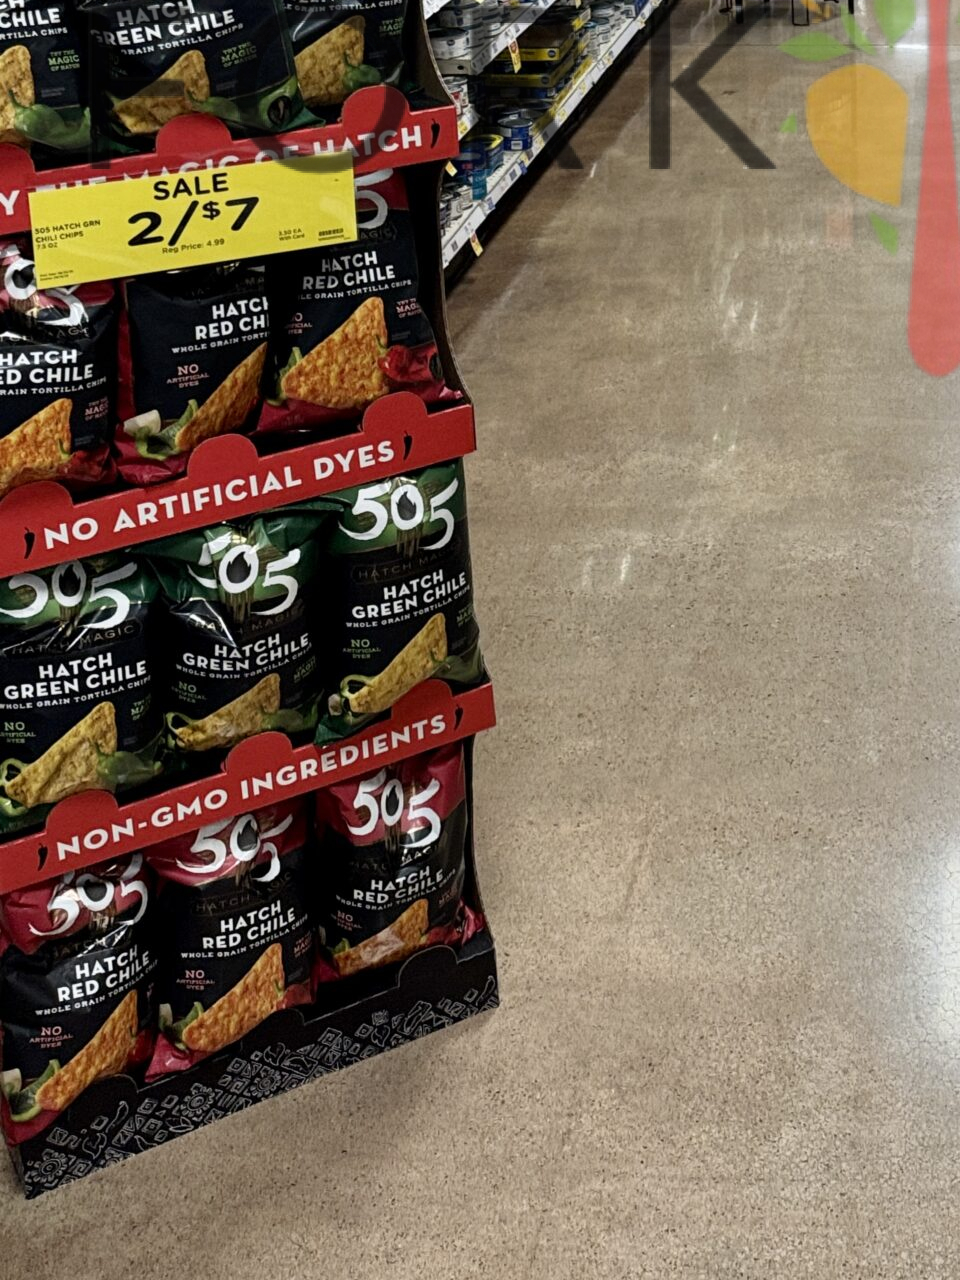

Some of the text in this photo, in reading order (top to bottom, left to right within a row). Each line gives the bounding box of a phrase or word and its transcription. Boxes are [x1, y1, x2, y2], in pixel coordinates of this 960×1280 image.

[117, 0, 195, 27] HATCH
[168, 9, 235, 37] CHILE
[313, 124, 422, 158] HATCH
[153, 172, 229, 200] SALE
[35, 219, 101, 235] 505 HATCH GRN
[128, 197, 259, 247] 2/$7
[35, 230, 84, 243] CHILI CHIPS
[162, 245, 179, 255] Reg
[206, 238, 225, 247] 4.99
[321, 250, 378, 274] HATCH
[302, 265, 396, 291] RED CHILE
[346, 284, 389, 297] TORTILLA
[195, 321, 233, 341] RED
[172, 342, 207, 354] WHOLE
[29, 363, 94, 385] CHILE
[177, 363, 199, 375] NO
[31, 383, 84, 395] TORTILLA
[44, 440, 394, 549] NO ARTIFICIAL DYES
[338, 477, 459, 550] 505
[352, 572, 467, 619] GREEN CHILE
[383, 568, 444, 600] HATCH
[345, 612, 411, 629] WHOLE GRAIN
[183, 633, 309, 672] GREEN CHILE
[214, 632, 281, 659] HATCH
[38, 652, 113, 679] HATCH
[4, 660, 147, 700] GREEN CHILE
[36, 697, 70, 708] GRAIN
[4, 721, 26, 732] NO
[56, 713, 447, 861] NON-GMO INGREDIENTS
[346, 768, 441, 848] 505
[353, 868, 443, 904] RED CHILE
[370, 865, 430, 891] HATCH
[203, 907, 296, 949] RED CHILE
[220, 900, 281, 933] HATCH
[75, 944, 139, 980] HATCH
[181, 947, 247, 960] WHOLE GRAIN
[57, 950, 150, 1003] RED CHILE
[185, 970, 205, 979] NO
[35, 995, 106, 1016] WHOLE GRAIN
[40, 1026, 62, 1037] NO
